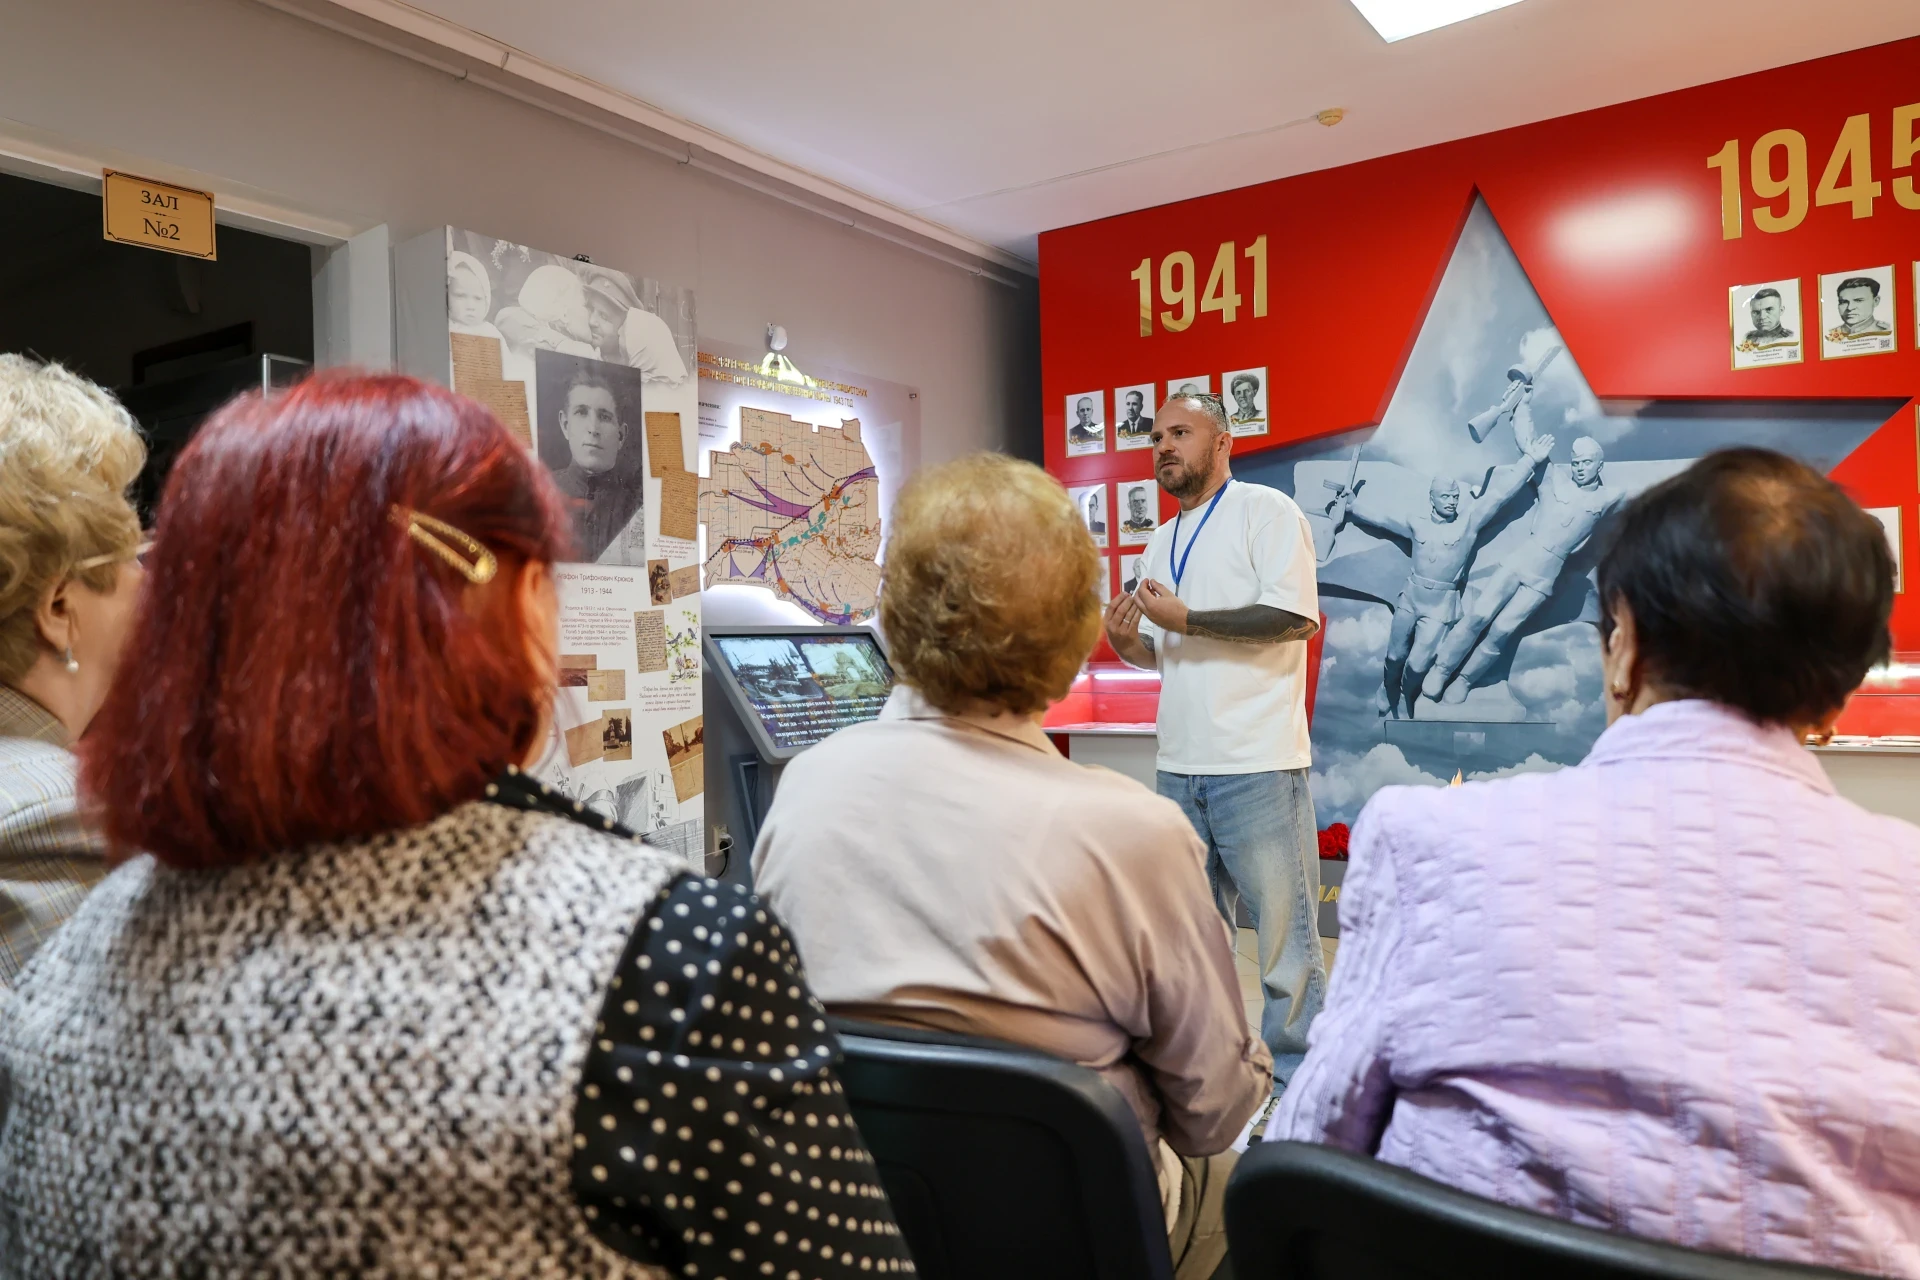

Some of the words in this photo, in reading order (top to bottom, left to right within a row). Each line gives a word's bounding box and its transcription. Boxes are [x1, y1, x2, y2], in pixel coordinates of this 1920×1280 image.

[140, 190, 179, 211] ЗАЛ
[143, 218, 180, 241] №2
[1131, 234, 1268, 337] 1941
[761, 711, 809, 720] Краснодарского
[776, 730, 808, 738] широкими
